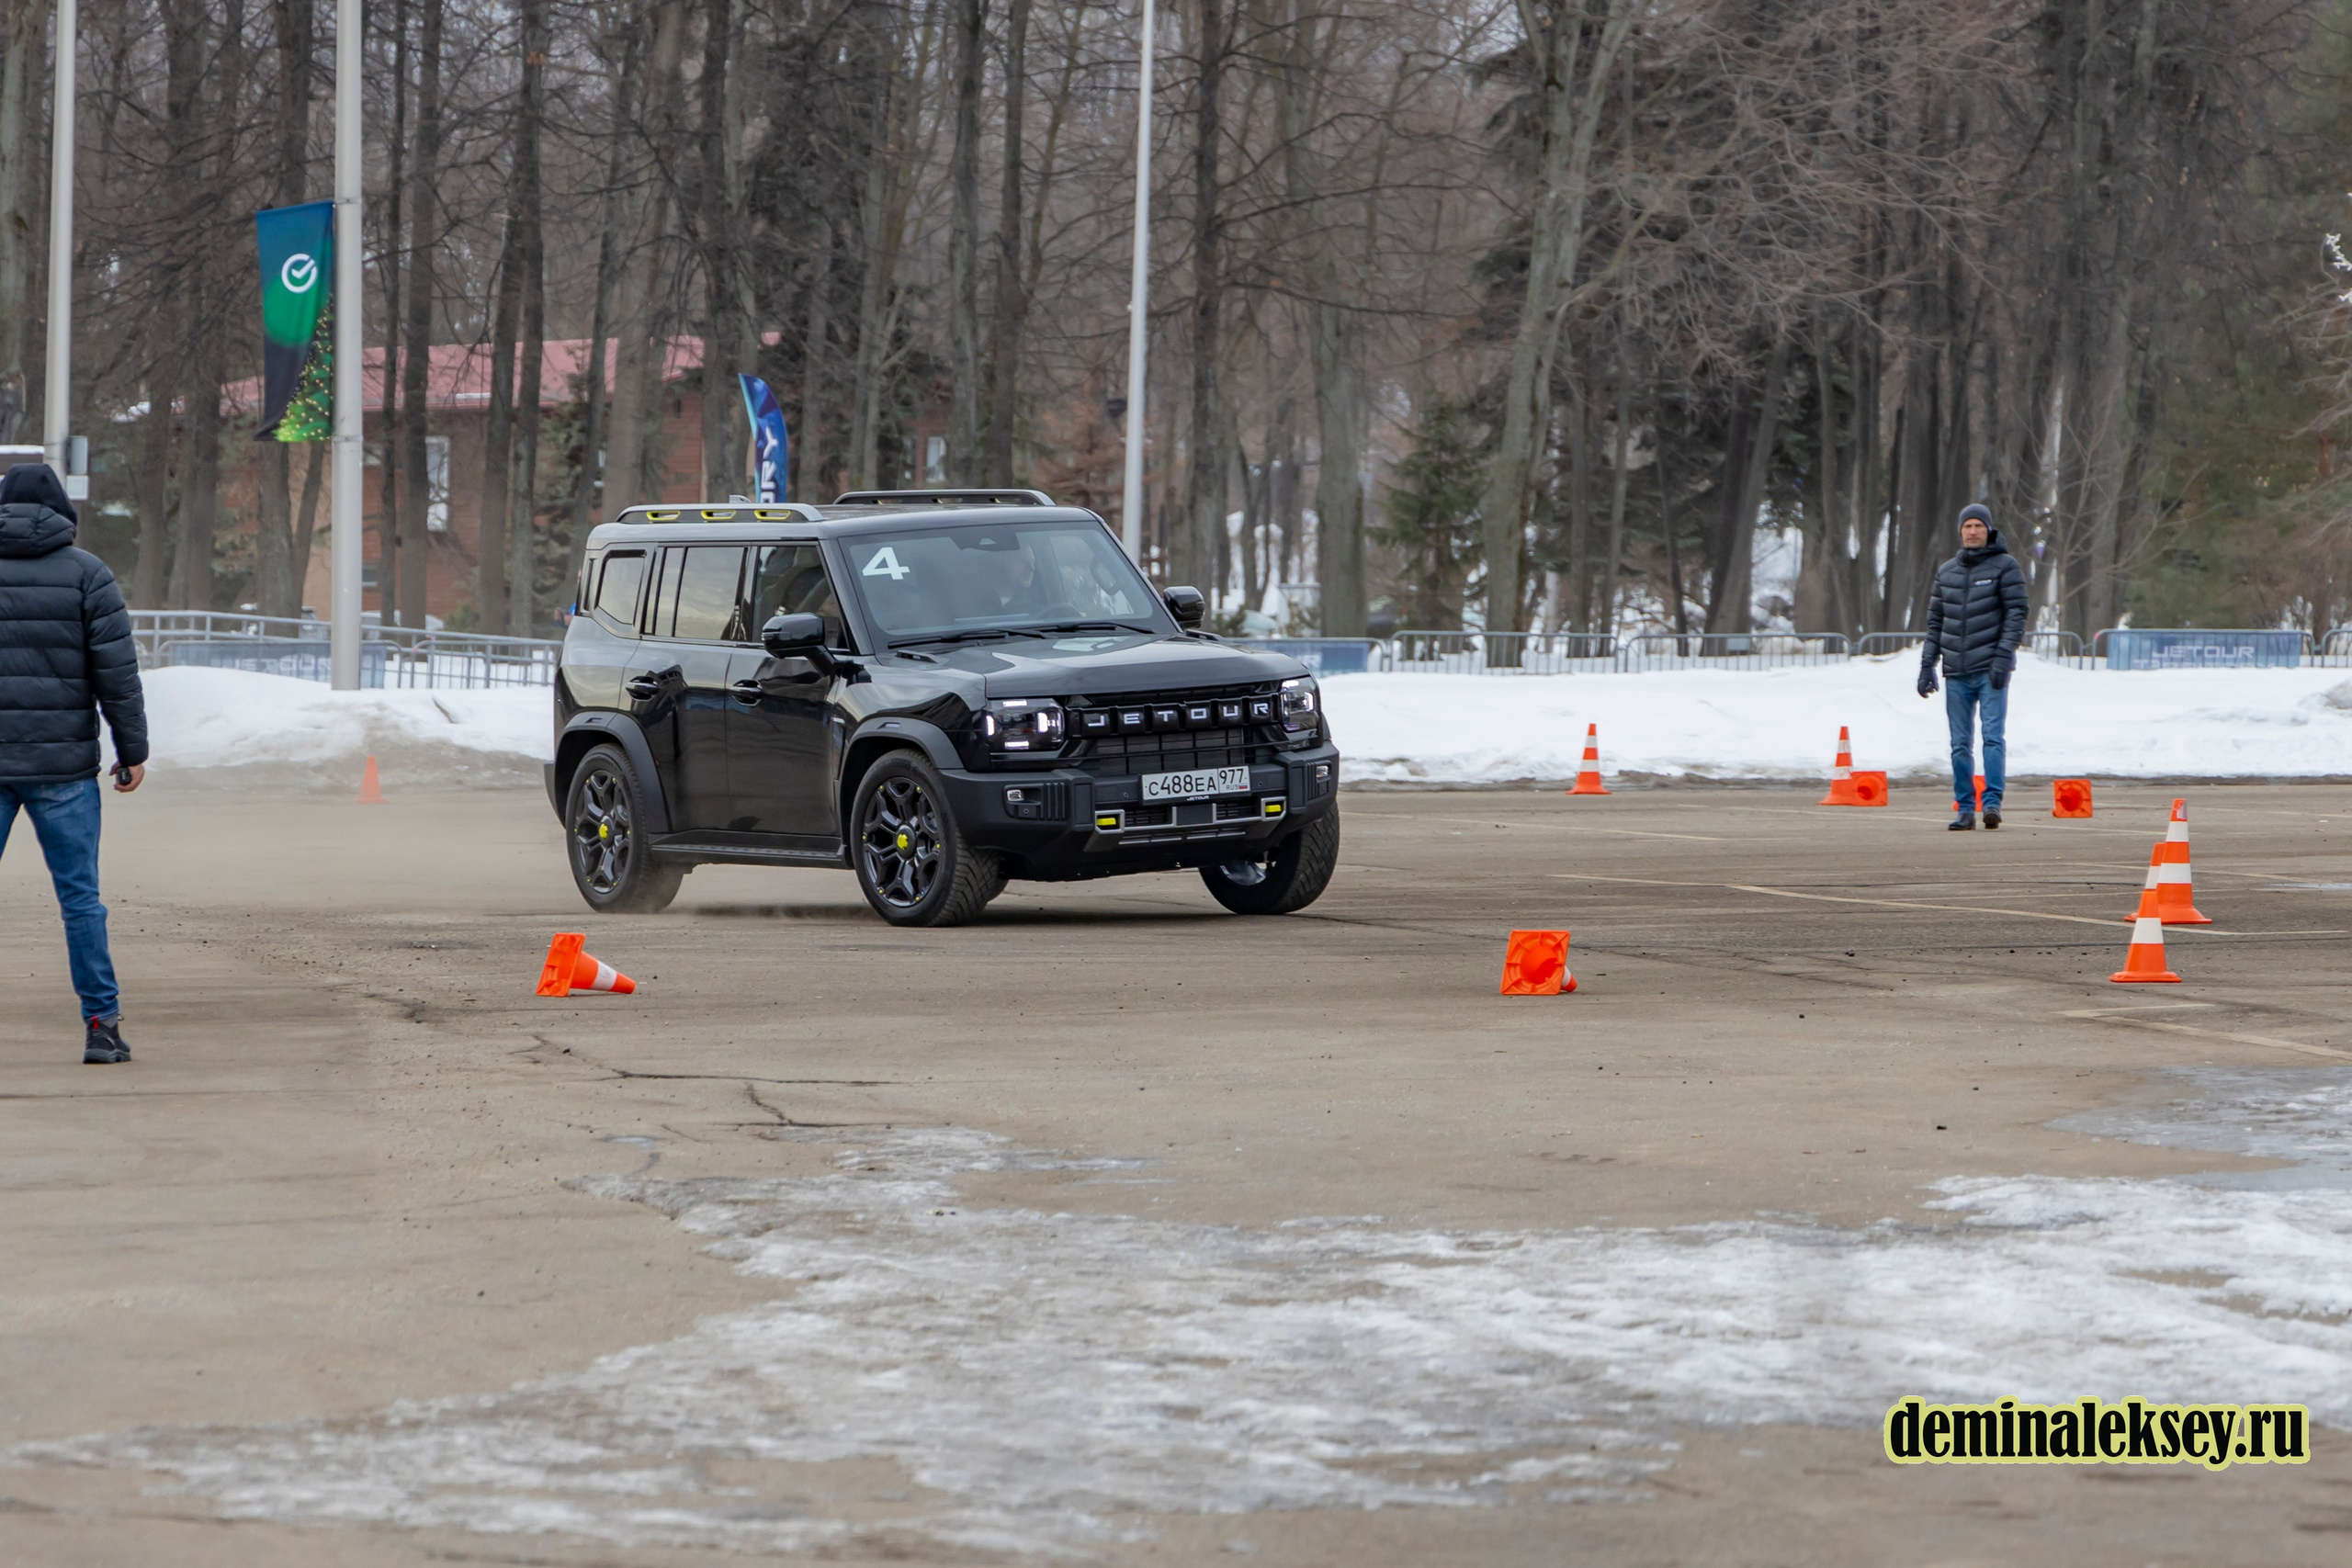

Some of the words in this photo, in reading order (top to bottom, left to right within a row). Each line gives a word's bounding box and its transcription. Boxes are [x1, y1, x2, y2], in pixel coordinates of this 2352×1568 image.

[862, 547, 910, 581] 4
[2152, 646, 2256, 659] JETOUR
[1088, 703, 1268, 727] JETOUR
[1219, 768, 1244, 784] 977
